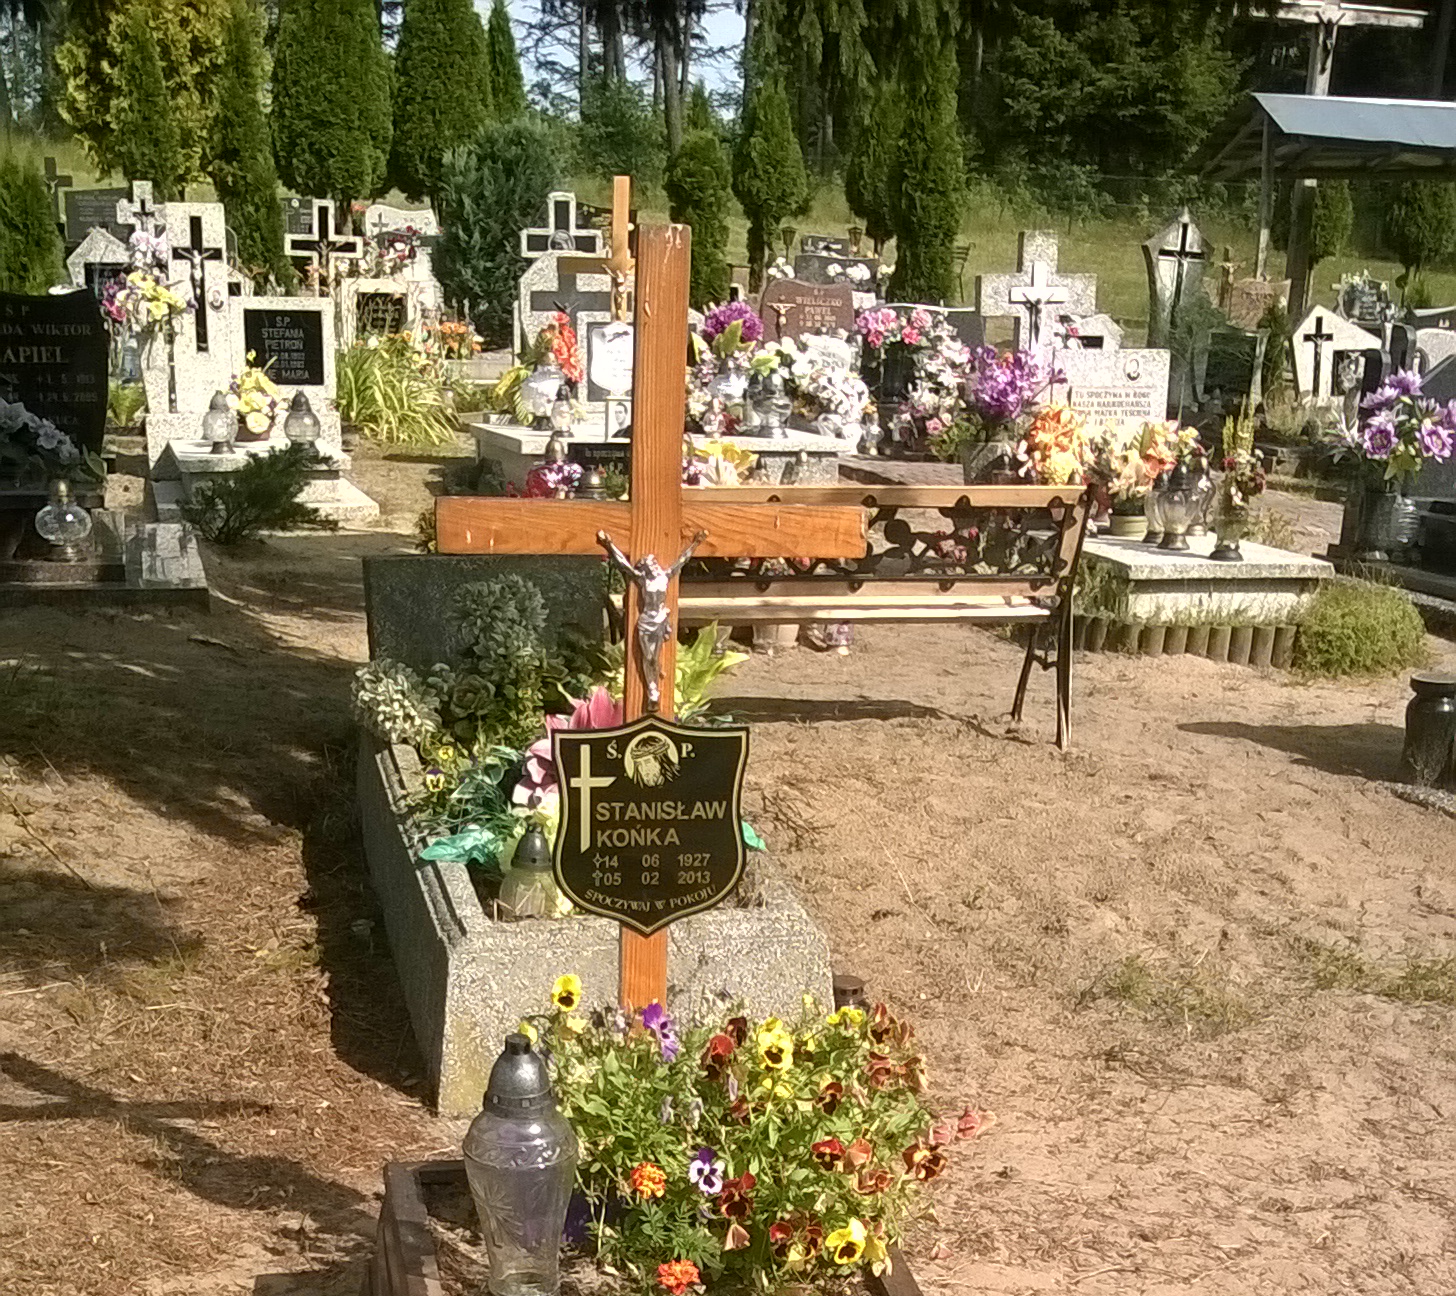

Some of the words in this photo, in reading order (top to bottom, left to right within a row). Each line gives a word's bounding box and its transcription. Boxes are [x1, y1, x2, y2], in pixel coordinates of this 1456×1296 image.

[30, 323, 92, 336] WIKTOR
[261, 327, 305, 339] STEFANIA
[0, 346, 69, 363] APIEL
[281, 369, 310, 380] MARIA
[1094, 409, 1118, 417] MATKA
[606, 739, 622, 759] Ś.
[680, 742, 696, 758] P.
[595, 800, 727, 821] STANISŁAW
[596, 824, 681, 848] KOŃKA
[641, 853, 660, 868] 06
[677, 852, 711, 868] 1927
[641, 871, 660, 886] 02
[677, 870, 711, 885] 2013
[584, 888, 651, 912] SPOCZYWAJ
[655, 900, 666, 910] W
[669, 884, 718, 909] POKOJU
